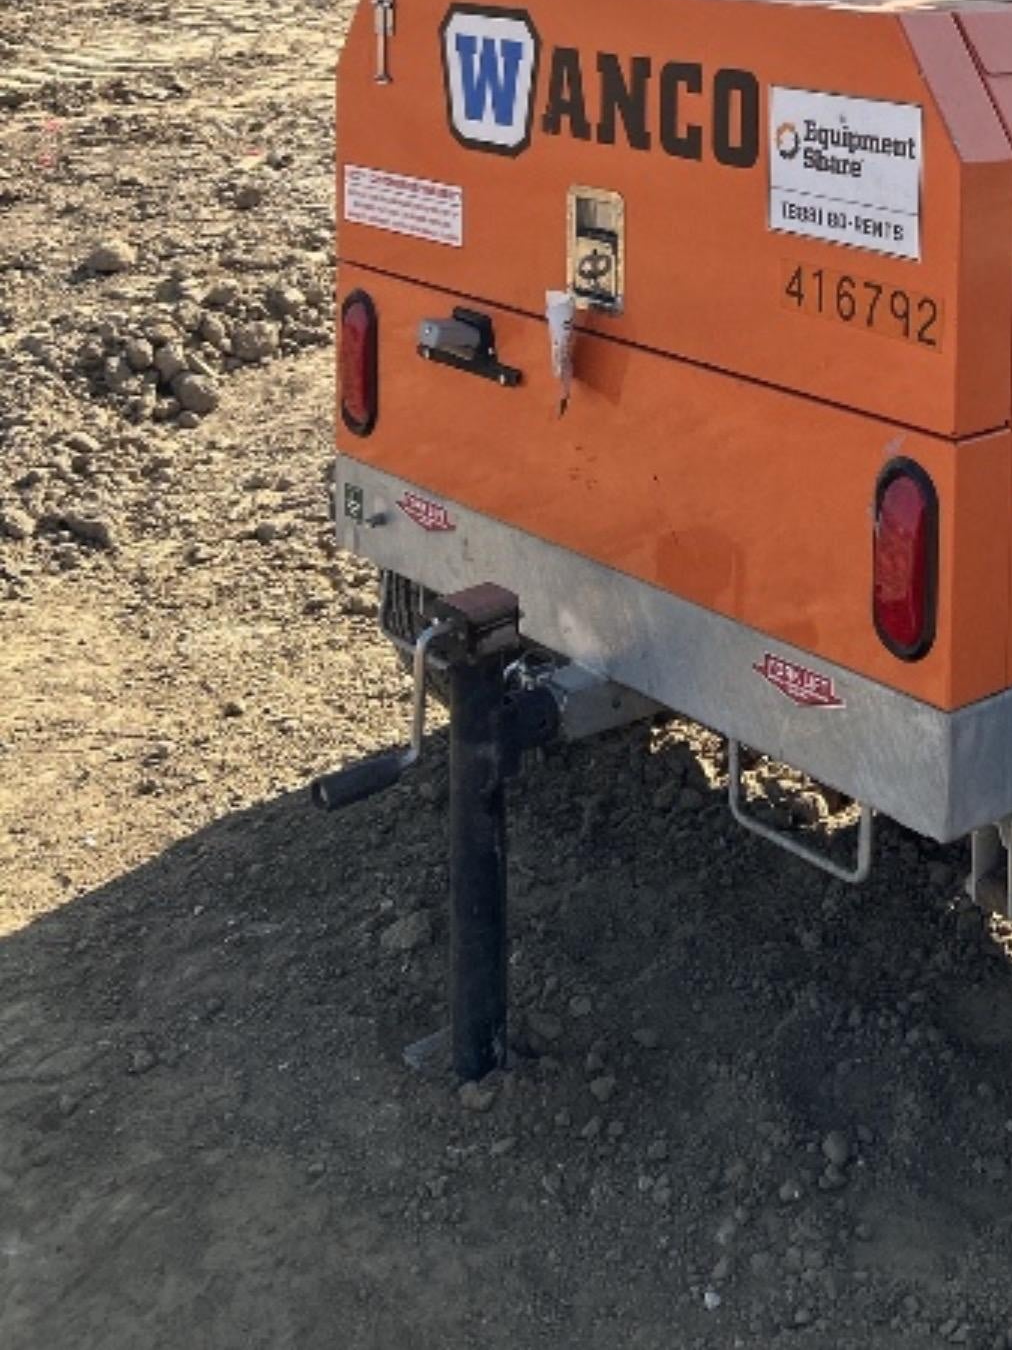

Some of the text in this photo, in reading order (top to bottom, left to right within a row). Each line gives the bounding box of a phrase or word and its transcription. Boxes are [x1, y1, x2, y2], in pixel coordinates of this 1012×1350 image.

[455, 33, 759, 168] WANCO
[803, 119, 916, 159] Equipment
[803, 147, 862, 178] Share
[785, 265, 937, 346] 416792
